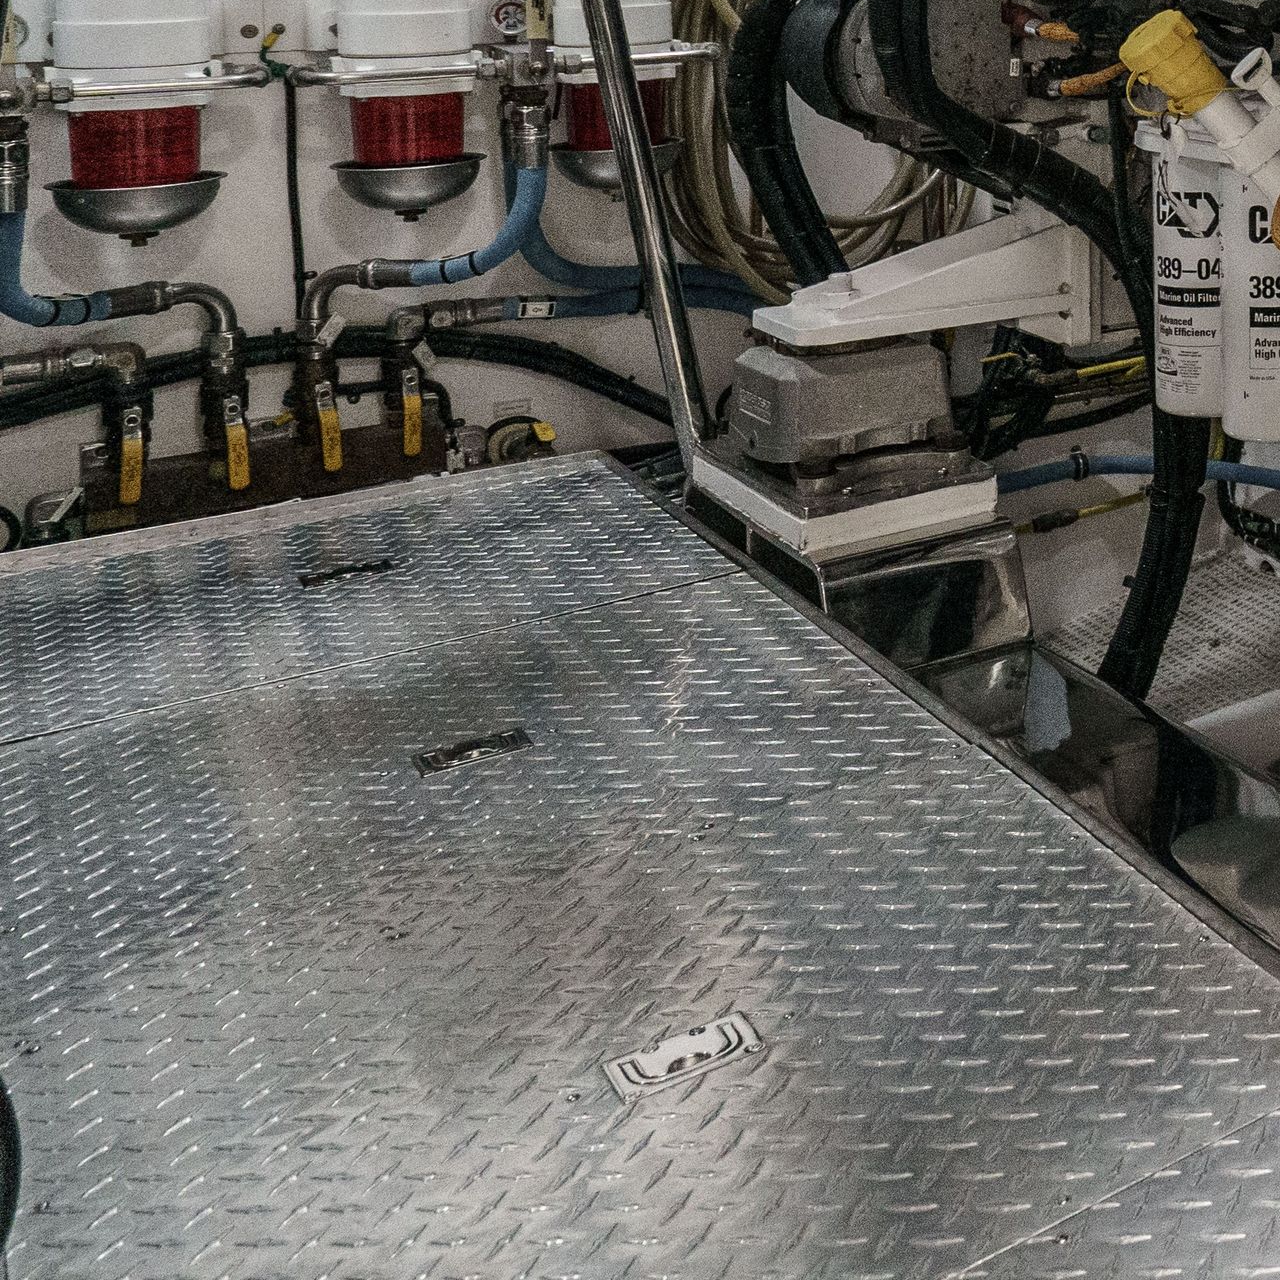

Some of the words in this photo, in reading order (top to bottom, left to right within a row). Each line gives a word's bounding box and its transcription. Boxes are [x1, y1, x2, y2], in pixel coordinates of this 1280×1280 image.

[1159, 290, 1182, 301] Marine
[1183, 293, 1196, 302] Oil
[1160, 314, 1193, 326] Advanced
[1174, 327, 1217, 339] Efficiency
[1254, 349, 1276, 360] High
